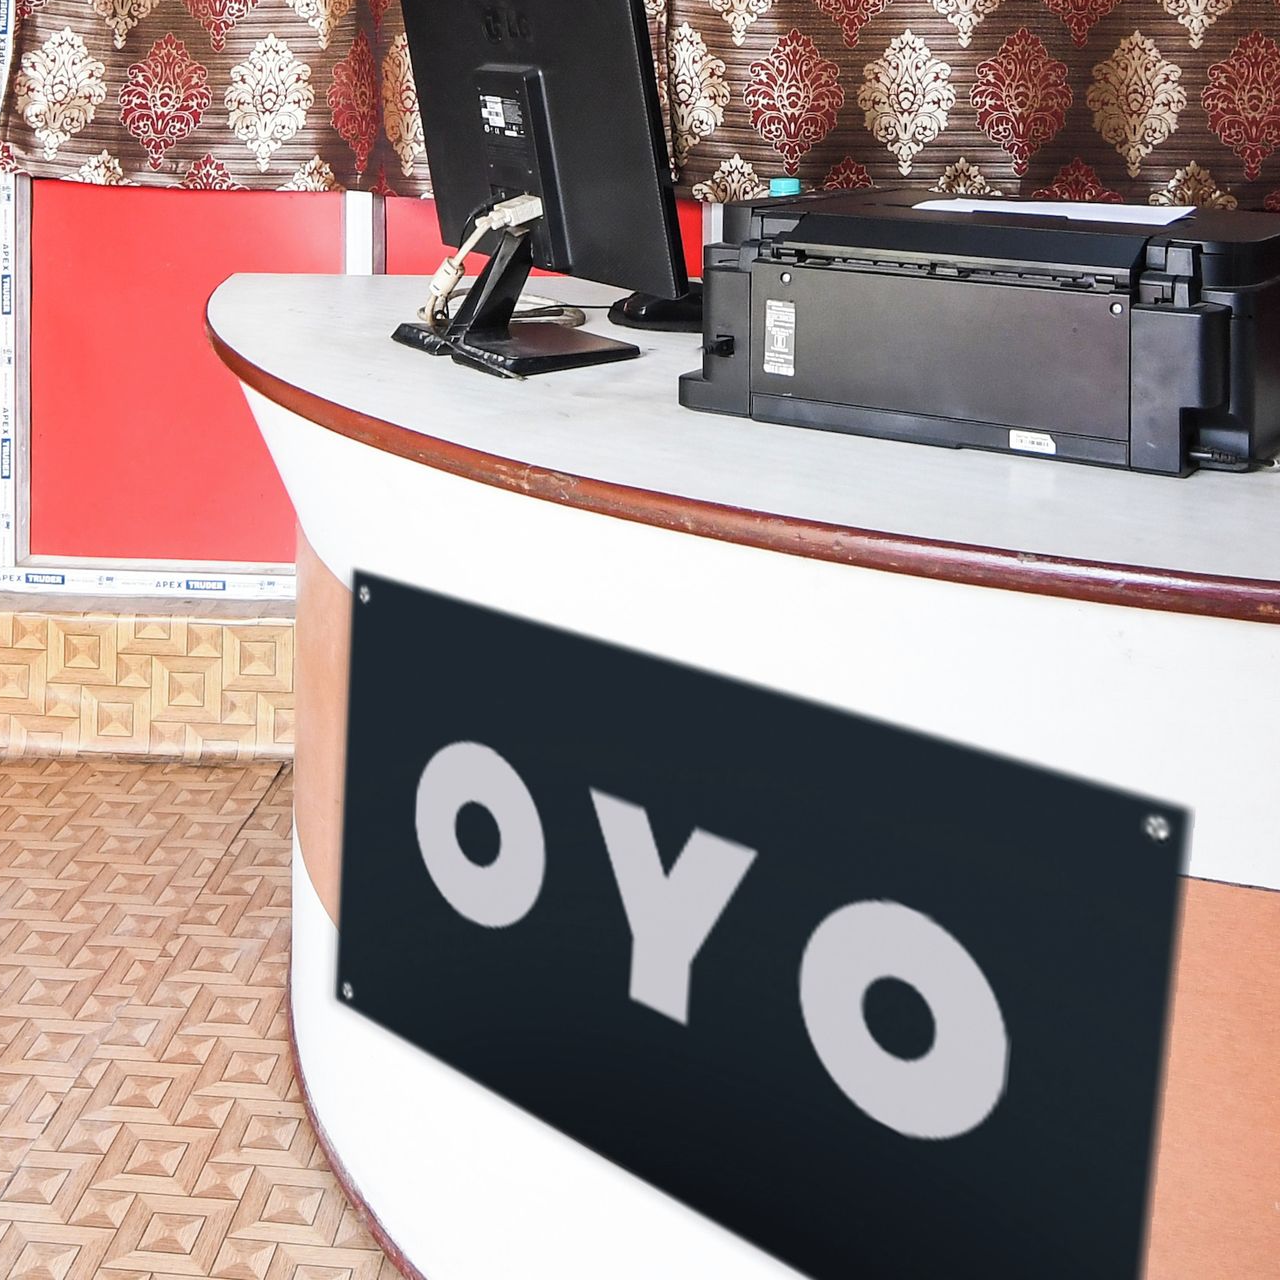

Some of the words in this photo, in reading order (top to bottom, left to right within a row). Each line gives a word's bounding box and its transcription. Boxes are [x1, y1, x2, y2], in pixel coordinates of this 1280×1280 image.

[2, 243, 10, 271] APEX
[2, 407, 10, 435] APEX
[155, 581, 182, 589] APEX
[415, 740, 1011, 1140] OYO
